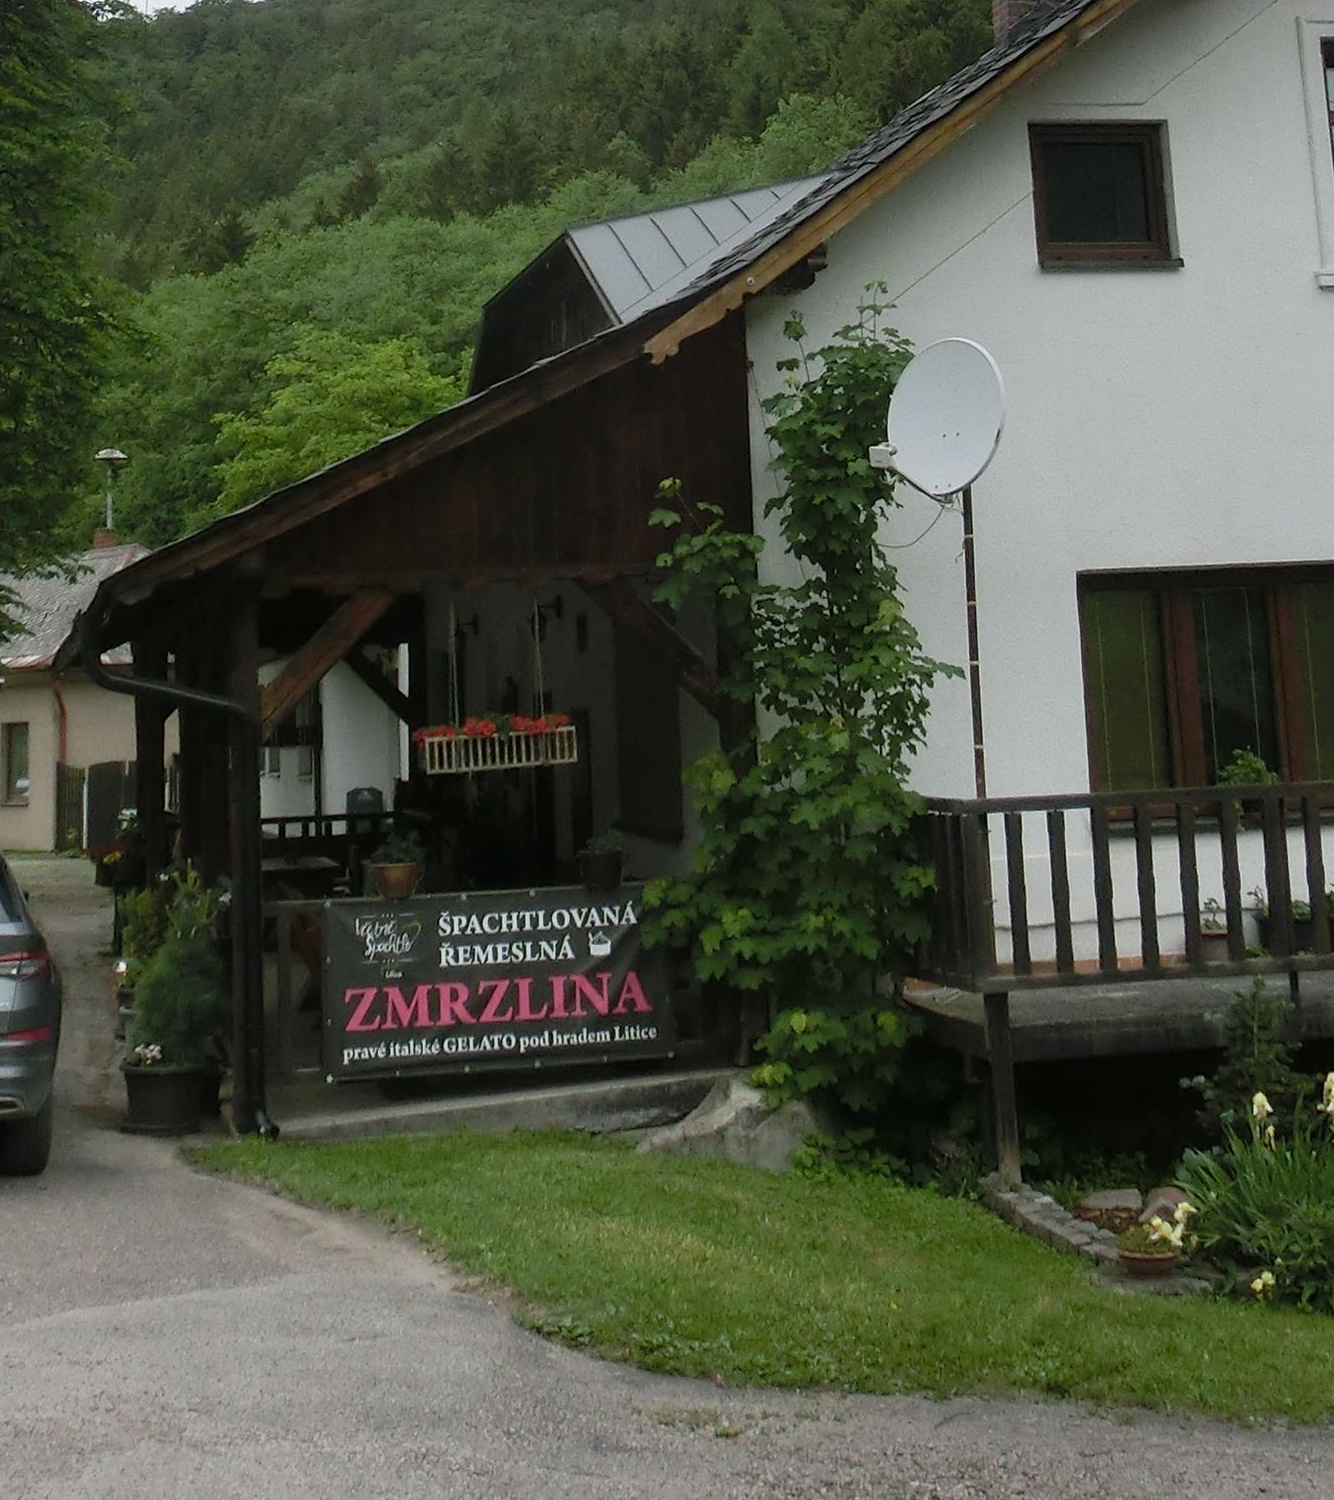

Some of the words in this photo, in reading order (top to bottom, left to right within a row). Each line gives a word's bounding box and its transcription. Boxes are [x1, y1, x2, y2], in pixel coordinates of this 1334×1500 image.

[438, 901, 639, 937] ŠPACHTLOVANÁ
[438, 936, 576, 968] ŘEMESLNÁ
[343, 970, 654, 1033] ZMRZLINA
[343, 1041, 387, 1065] pravé
[389, 1038, 440, 1057] italské
[443, 1034, 516, 1053] GELATO
[519, 1030, 549, 1053] pod
[552, 1027, 611, 1046] hradem
[614, 1024, 658, 1041] Litice
